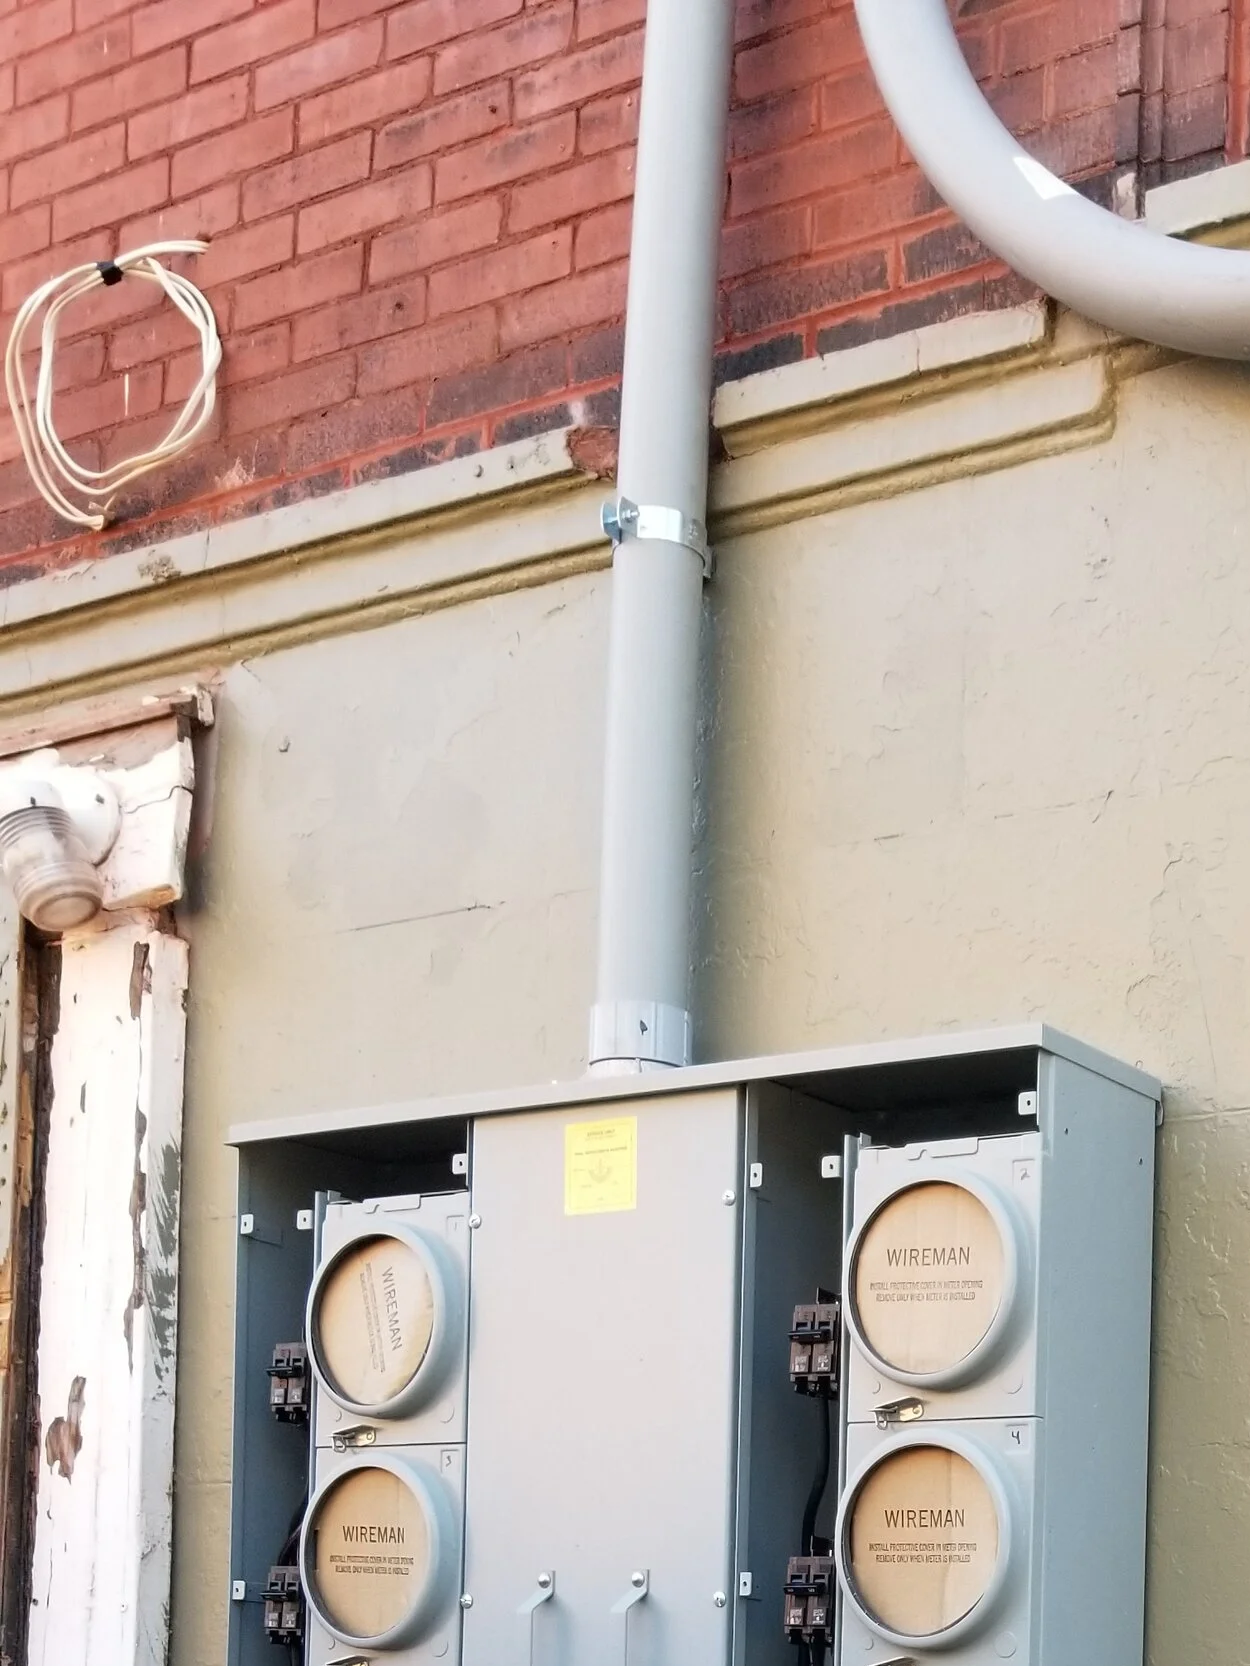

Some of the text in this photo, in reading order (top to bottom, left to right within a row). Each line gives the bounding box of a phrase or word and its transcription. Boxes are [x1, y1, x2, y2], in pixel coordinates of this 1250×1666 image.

[1019, 1167, 1031, 1180] 2
[886, 1246, 970, 1267] WIREMAN
[381, 1265, 403, 1352] WIREMAN
[1011, 1430, 1021, 1444] 4
[884, 1509, 965, 1528] WIREMAN
[342, 1525, 405, 1543] WIREMAN
